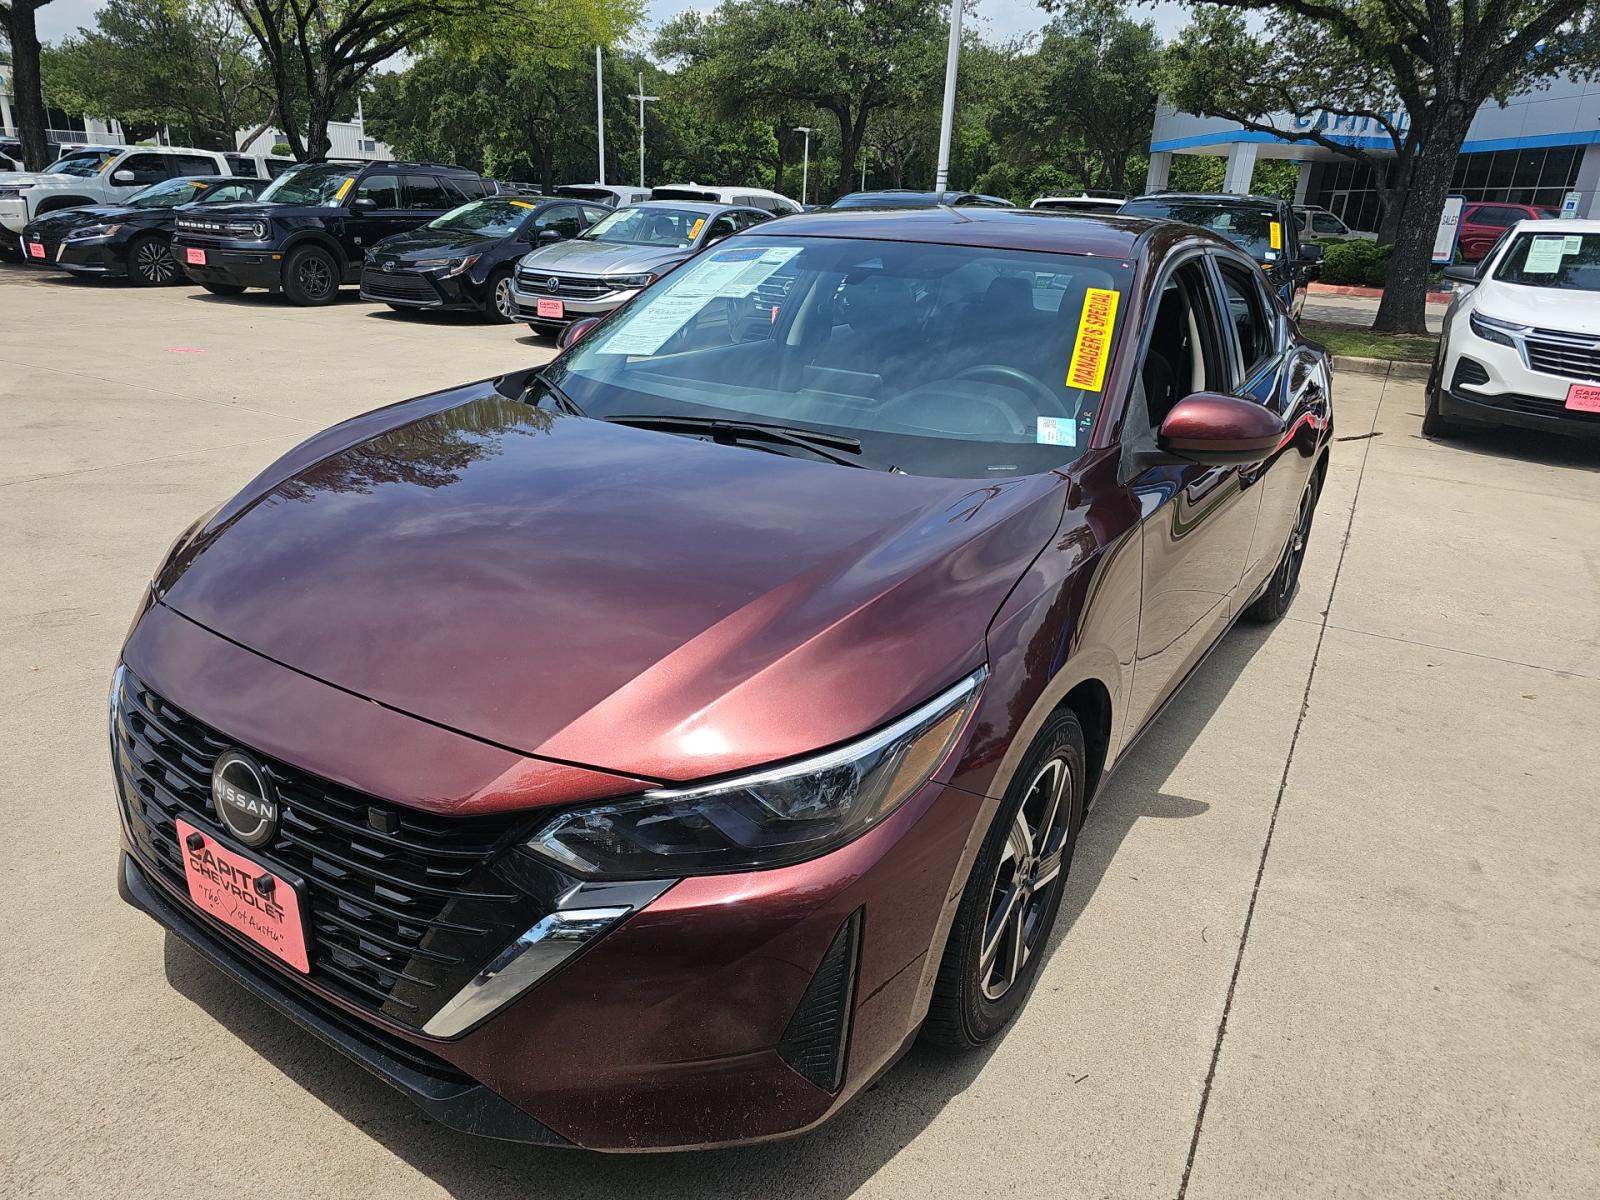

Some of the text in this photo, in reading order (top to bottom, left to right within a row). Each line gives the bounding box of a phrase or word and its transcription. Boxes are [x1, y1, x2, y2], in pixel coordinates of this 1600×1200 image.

[178, 221, 220, 230] BRONCO
[1441, 215, 1458, 226] SALES
[1073, 292, 1111, 387] MANAGER'S SPECIAL
[213, 777, 274, 819] NISSAN
[189, 857, 285, 924] CHEVROLET
